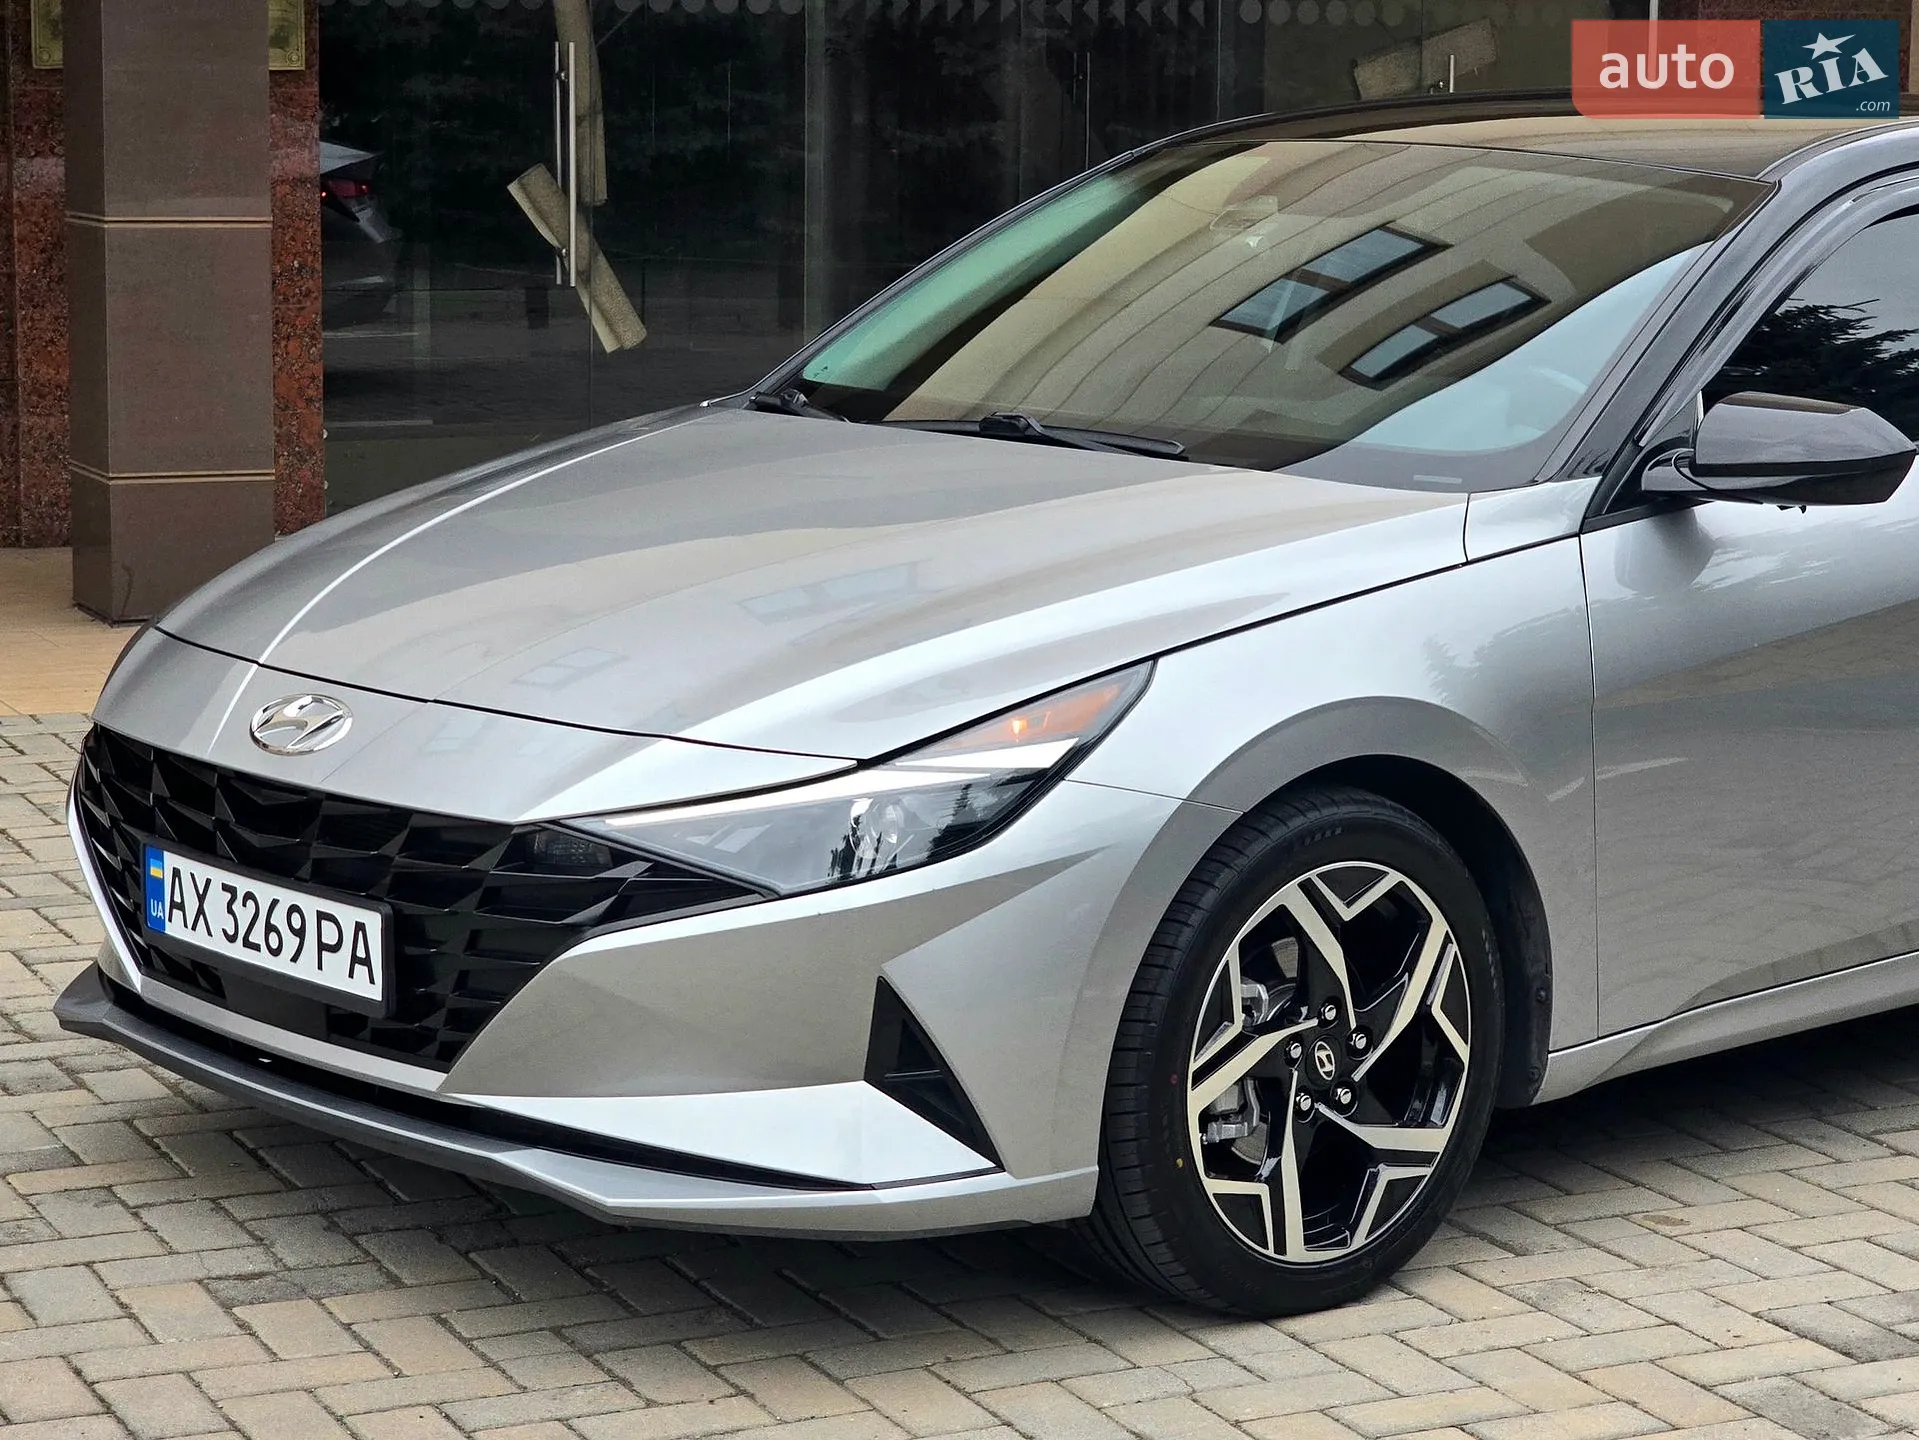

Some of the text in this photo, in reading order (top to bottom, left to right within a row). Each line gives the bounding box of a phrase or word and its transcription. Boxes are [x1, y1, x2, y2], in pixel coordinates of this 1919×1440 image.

[150, 899, 164, 920] UA
[167, 866, 376, 985] AX 3269 PA
